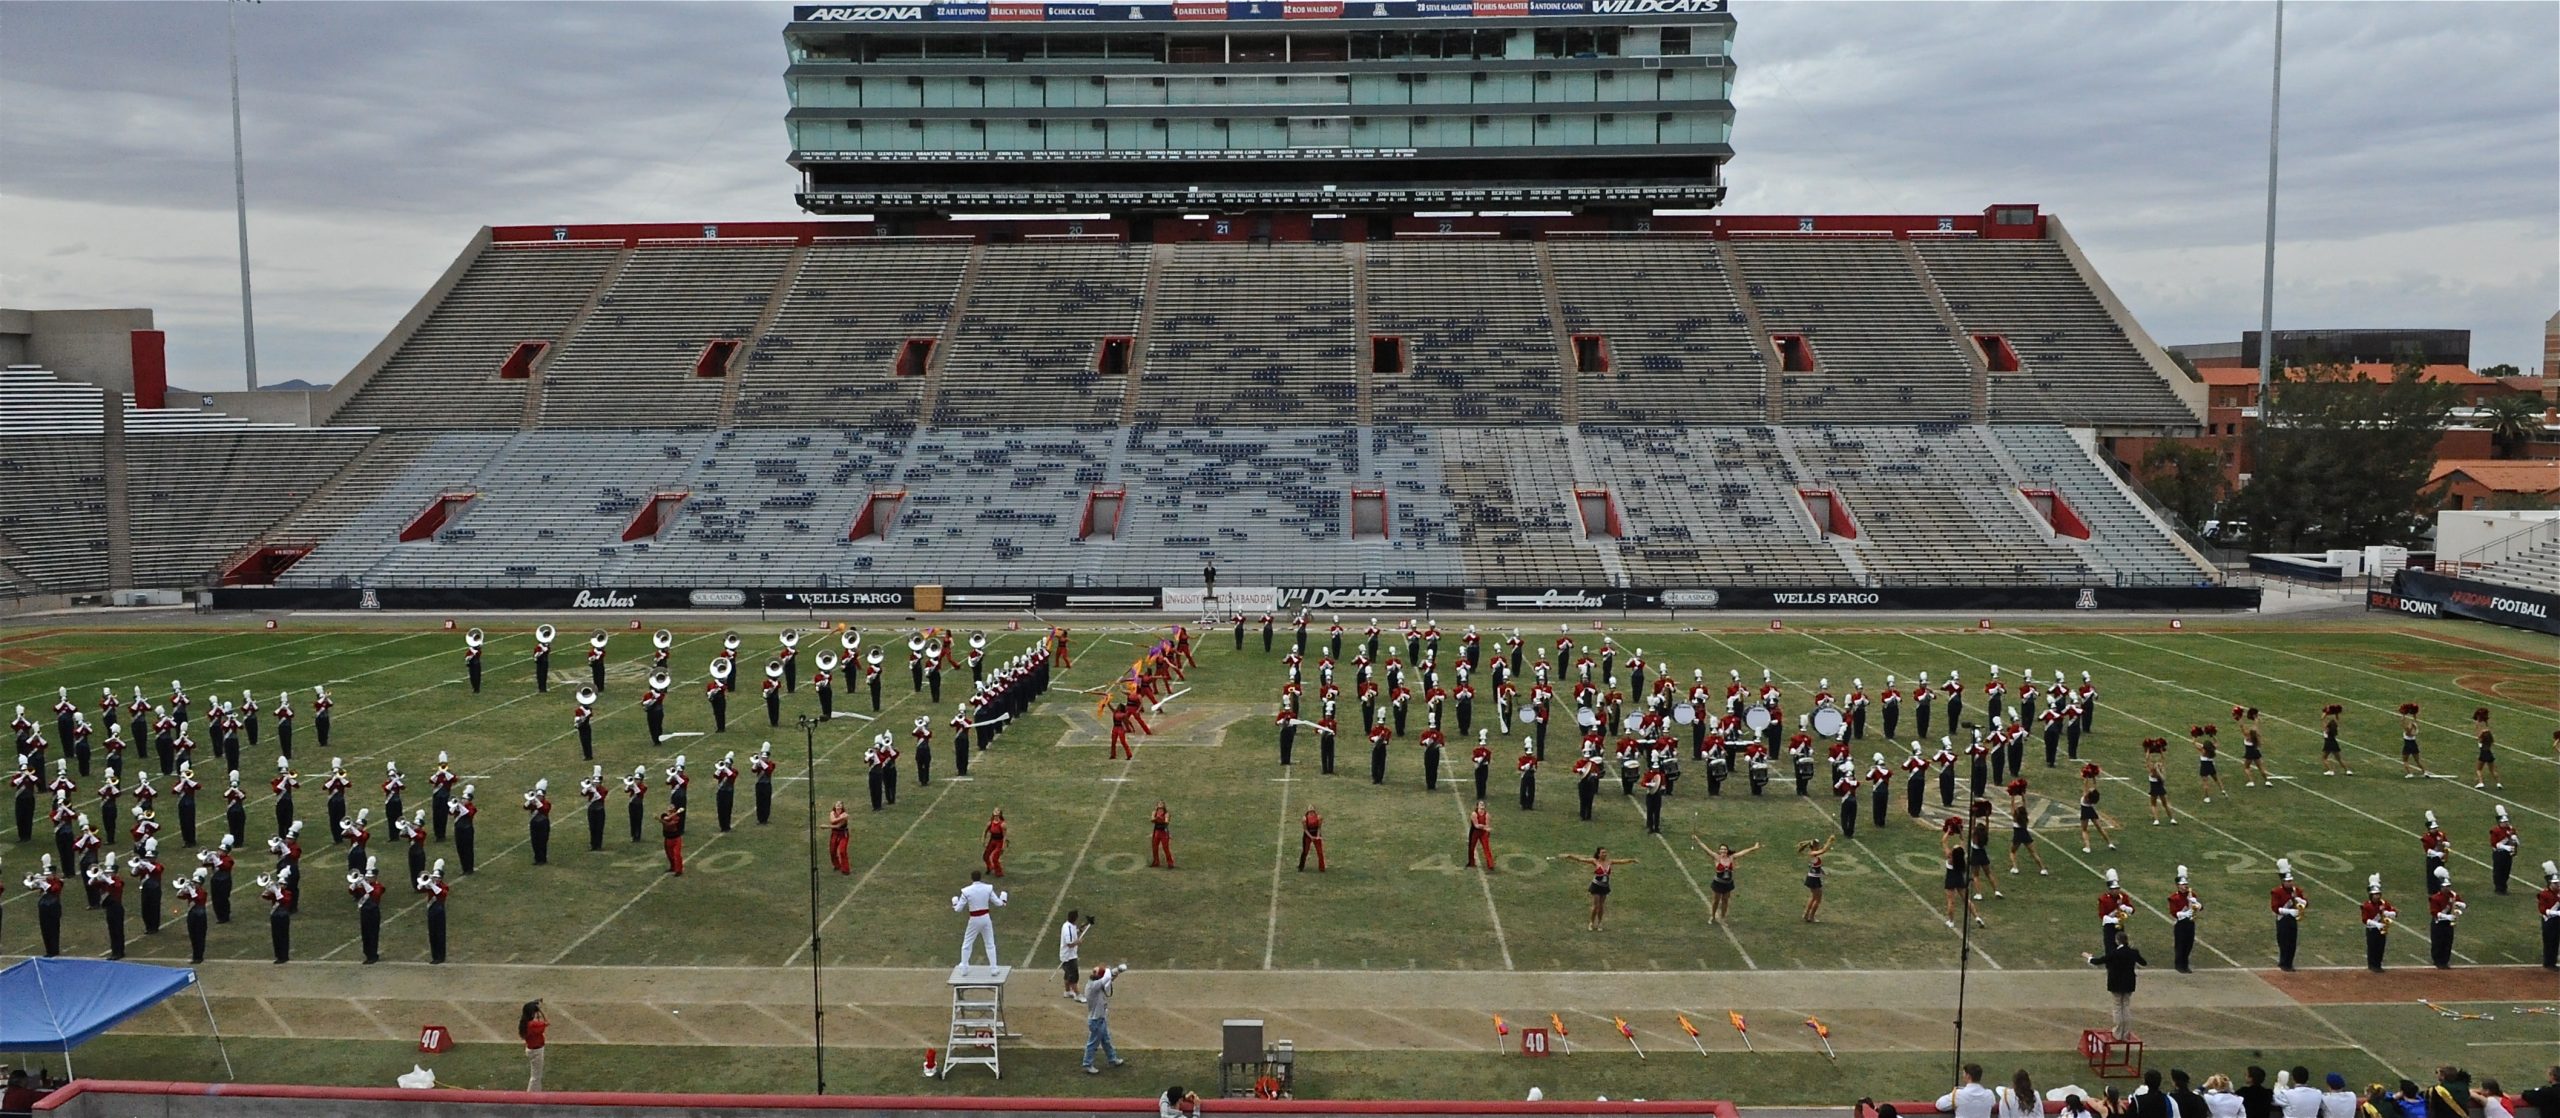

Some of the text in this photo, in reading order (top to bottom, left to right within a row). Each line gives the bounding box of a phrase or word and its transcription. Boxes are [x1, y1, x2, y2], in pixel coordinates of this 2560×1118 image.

[1479, 3, 1497, 11] CHRIS
[1592, 0, 1719, 13] WILDCATS
[807, 7, 922, 20] ARIZONA
[1019, 8, 1043, 16] HUNLEY
[1054, 8, 1076, 16] CHUCK
[1077, 8, 1095, 16] CECIL
[1179, 8, 1207, 16] DARRYLL
[876, 227, 886, 237] 19
[1069, 225, 1083, 235] 20
[1216, 224, 1229, 234] 21
[1439, 223, 1451, 233] 22
[1638, 222, 1650, 232] 23
[1800, 222, 1813, 232] 24
[1938, 222, 1951, 232] 25
[555, 231, 566, 241] 17
[704, 229, 717, 239] 18
[203, 396, 213, 405] 16
[573, 589, 638, 608] Bashas'
[799, 593, 902, 604] WELLS FARGO
[1241, 595, 1259, 604] BAND
[1260, 595, 1274, 604] DAY
[1773, 593, 1879, 604] WELLS FARGO
[2490, 597, 2547, 618] FOOTBALL
[421, 1029, 440, 1049] 40
[1526, 1032, 1544, 1052] 40
